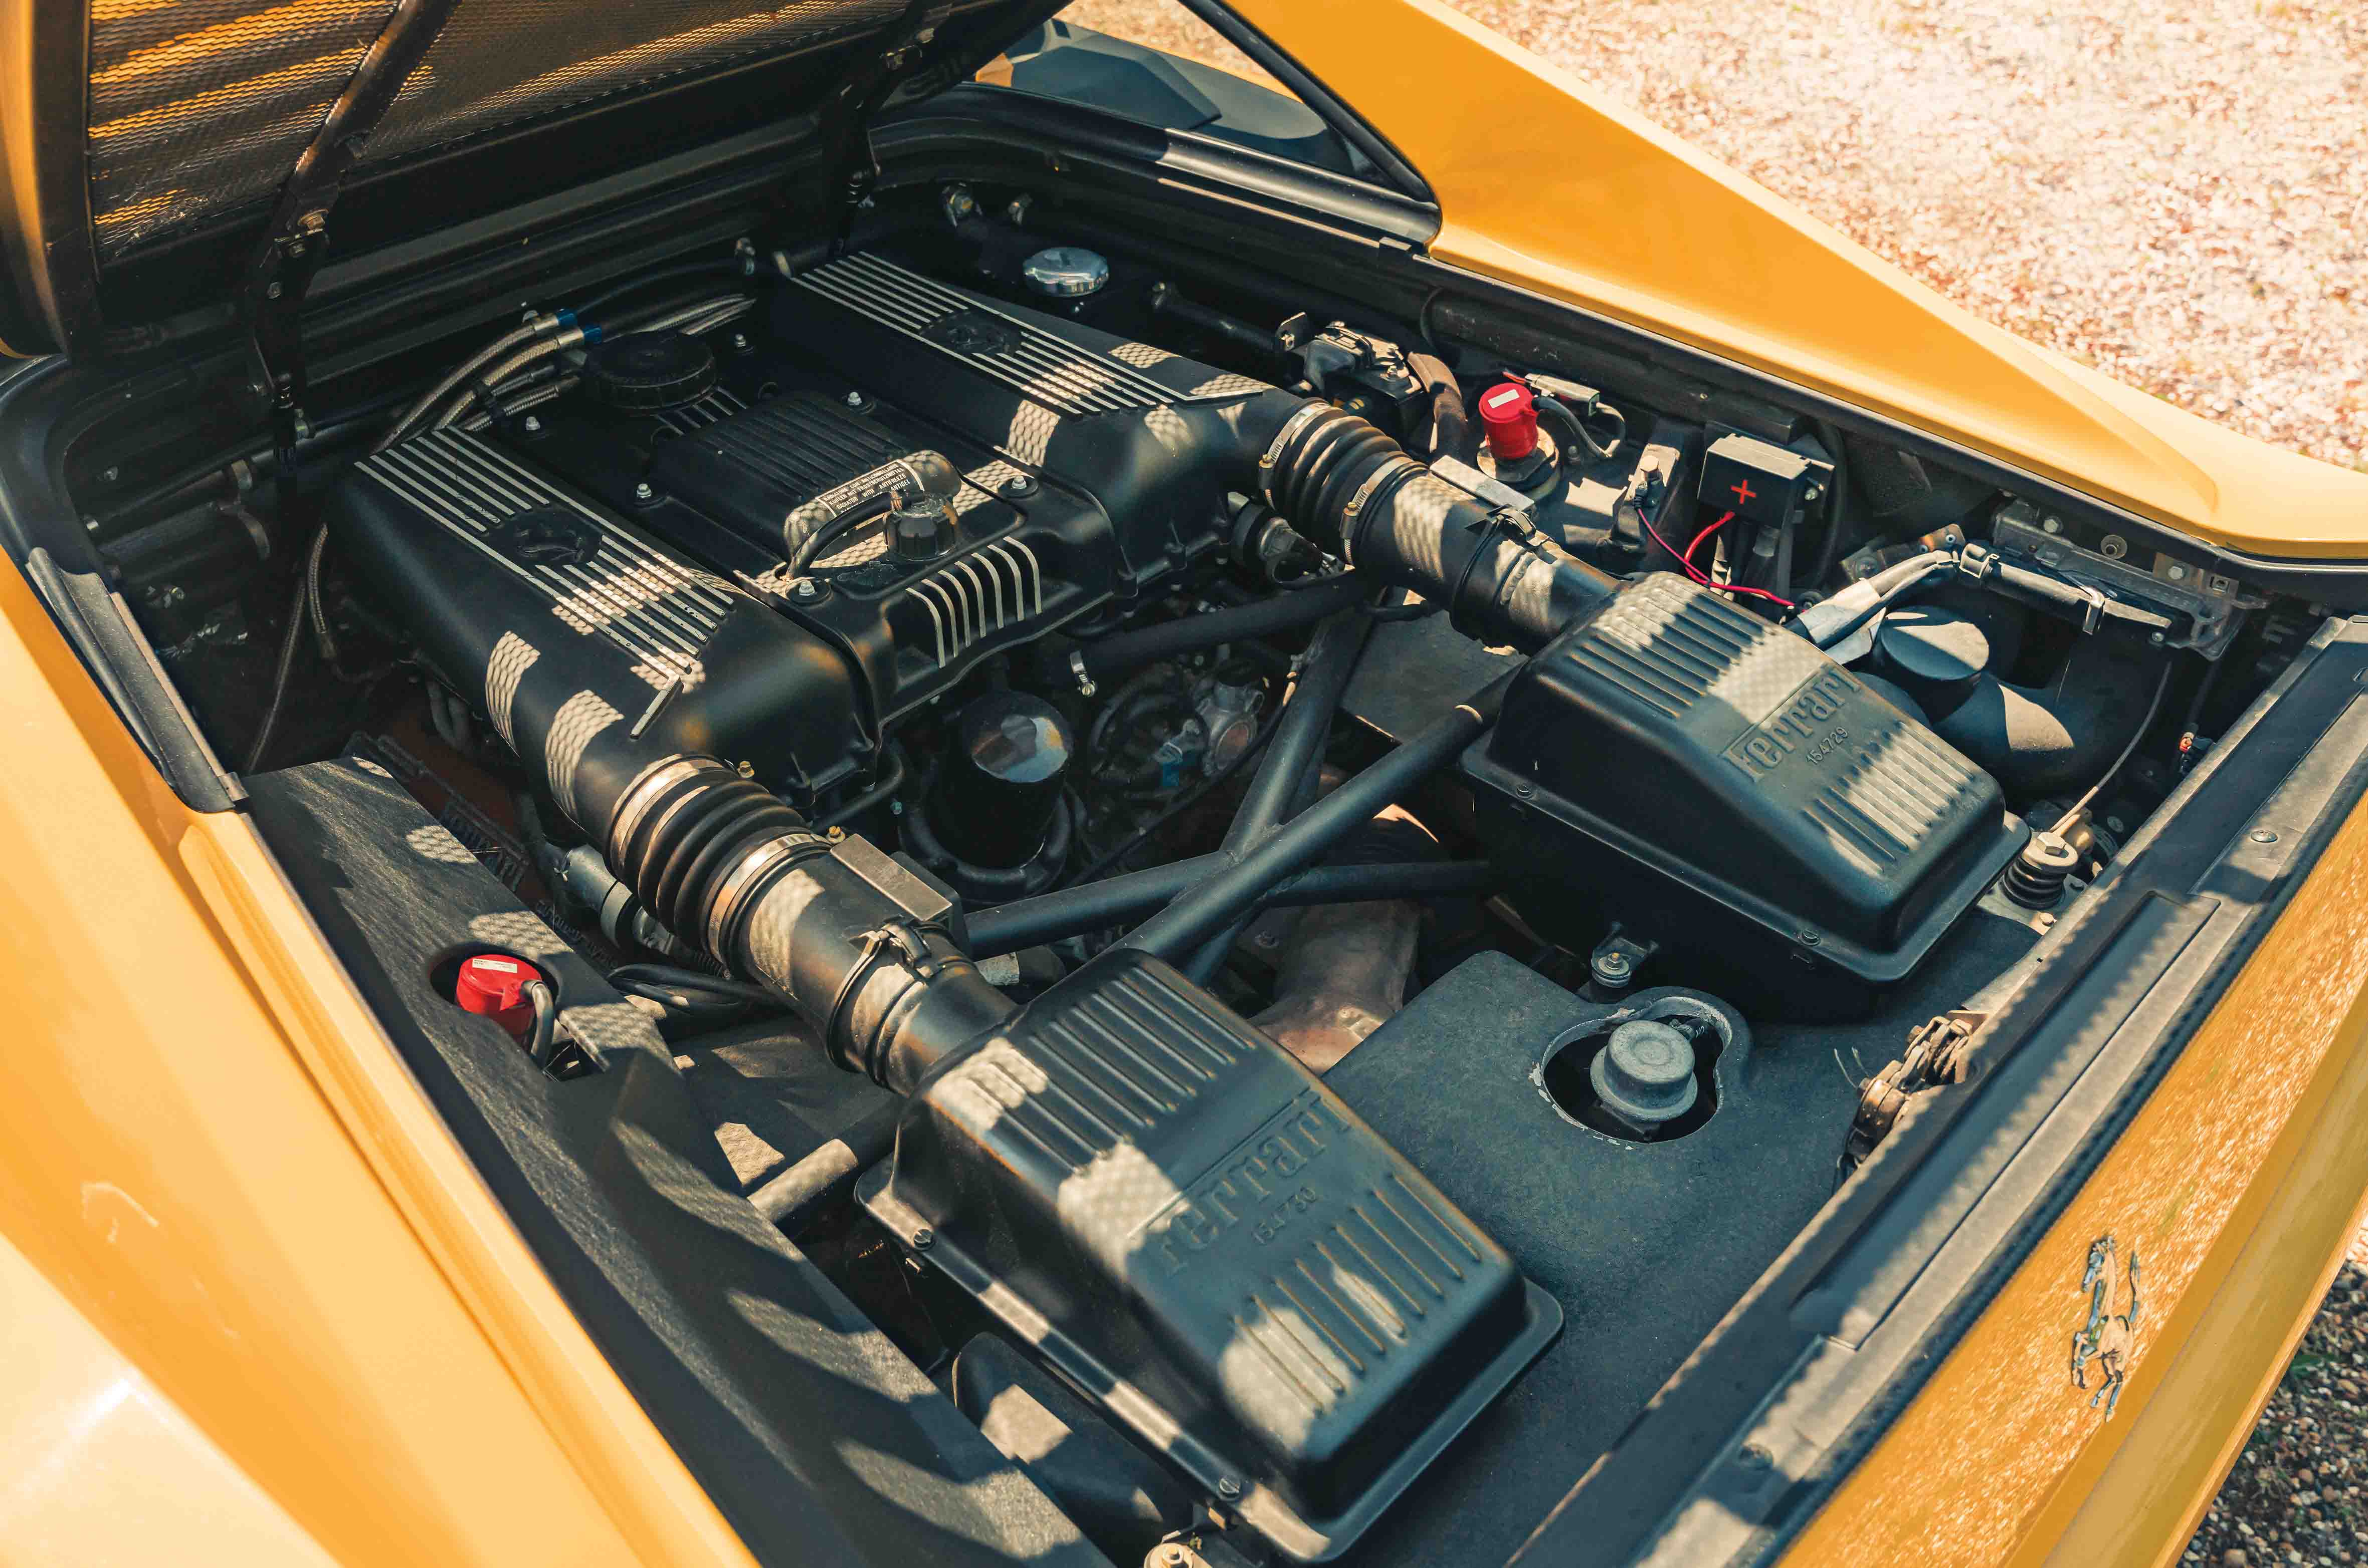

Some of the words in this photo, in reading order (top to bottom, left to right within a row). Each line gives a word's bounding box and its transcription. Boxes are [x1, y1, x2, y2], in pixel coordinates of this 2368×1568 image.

[828, 494, 848, 506] KÜHLER
[836, 496, 859, 510] RADIATOR
[862, 489, 875, 498] WITH
[879, 473, 906, 490] ANTIFREEZE
[890, 479, 911, 491] ANTIGEL
[1718, 662, 1861, 783] Ferrari
[1805, 727, 1848, 765] 154729
[1127, 1086, 1351, 1278] Ferrari
[1252, 1186, 1316, 1245] 154730
